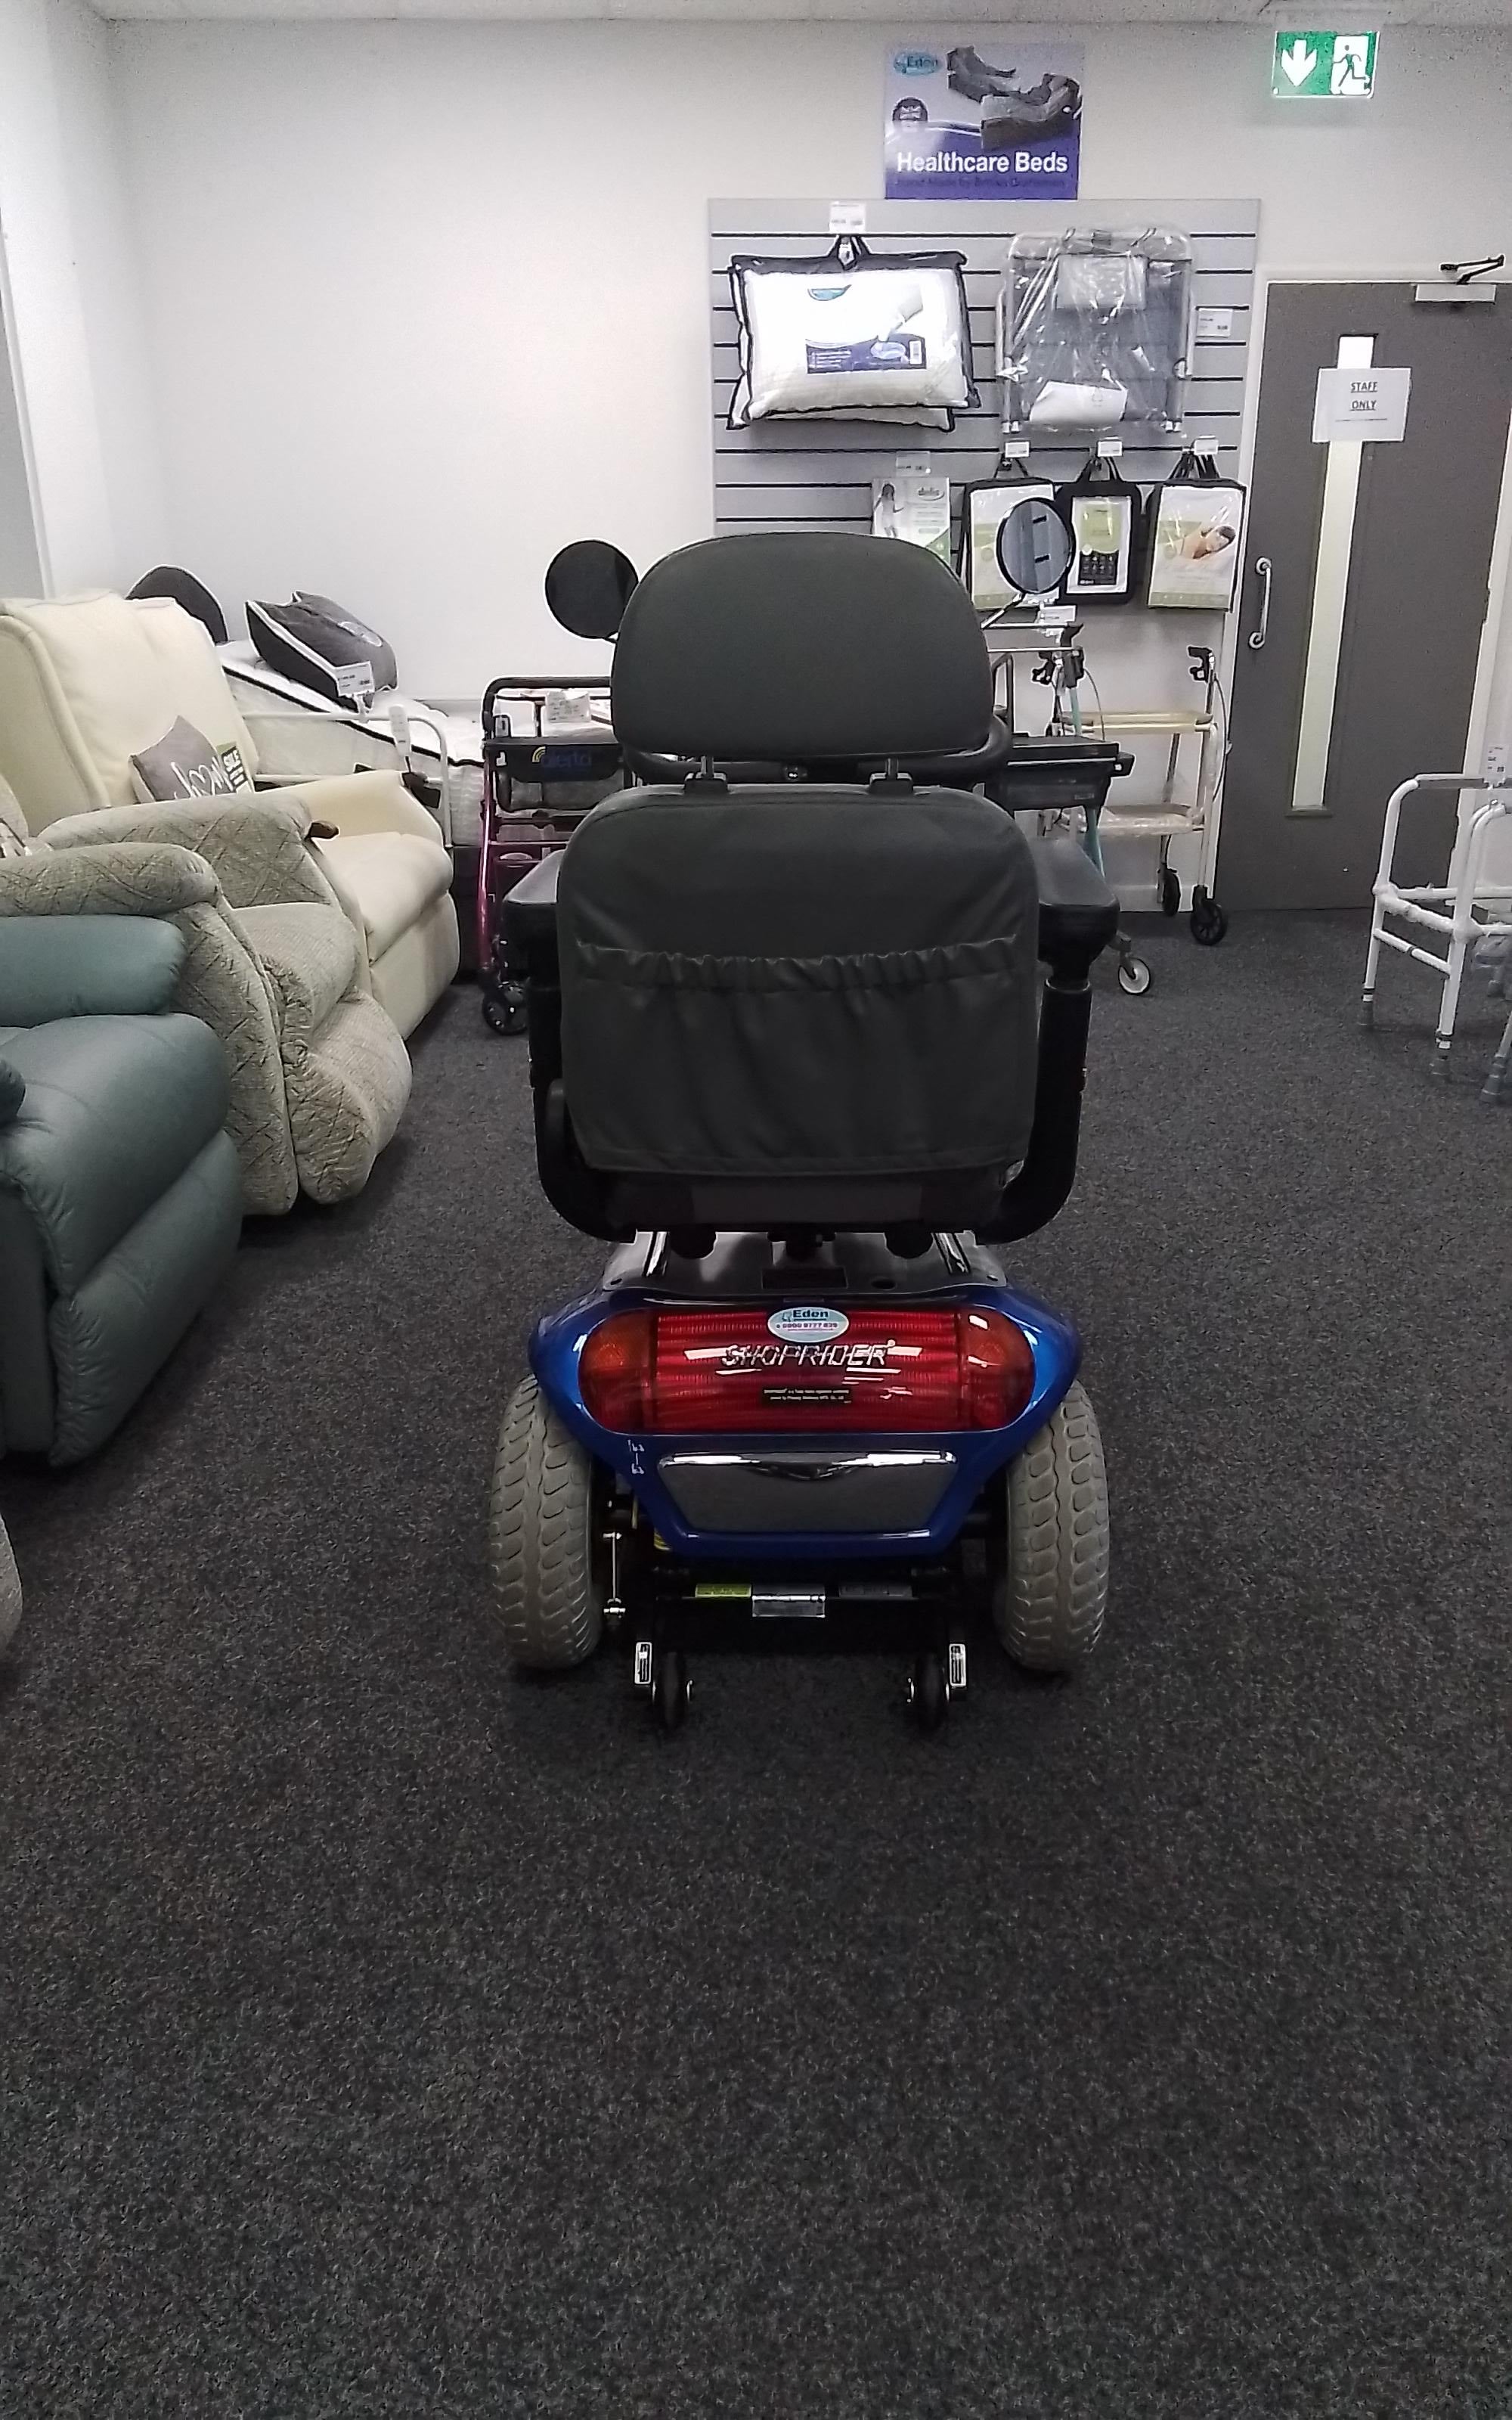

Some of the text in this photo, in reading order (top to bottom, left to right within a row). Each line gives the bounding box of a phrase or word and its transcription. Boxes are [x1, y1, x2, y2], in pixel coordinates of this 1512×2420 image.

[897, 151, 1068, 172] Healthcare Beds
[1350, 382, 1377, 392] STAFF
[1352, 400, 1377, 410] ONLY
[792, 1309, 829, 1318] Eden
[722, 1344, 886, 1366] SHOPRIDER
